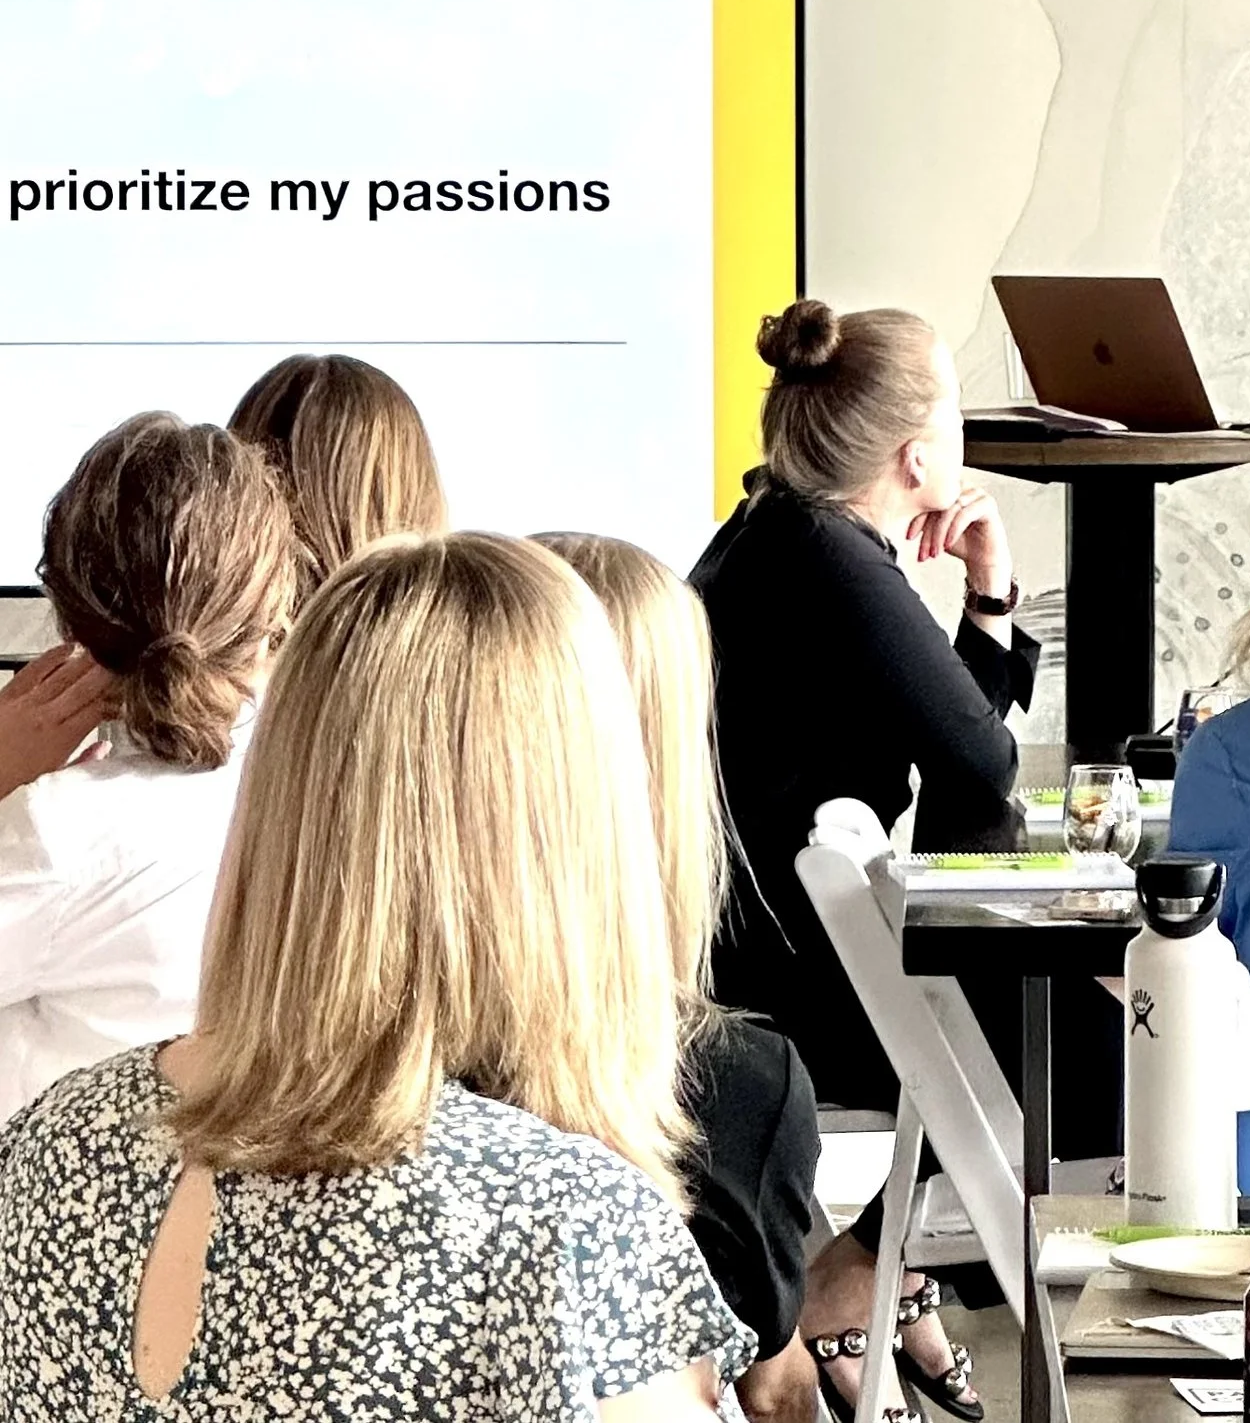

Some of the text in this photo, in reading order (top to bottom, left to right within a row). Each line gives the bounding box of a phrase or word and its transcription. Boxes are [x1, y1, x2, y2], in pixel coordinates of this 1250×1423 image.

[9, 169, 610, 222] prioritize my passions
